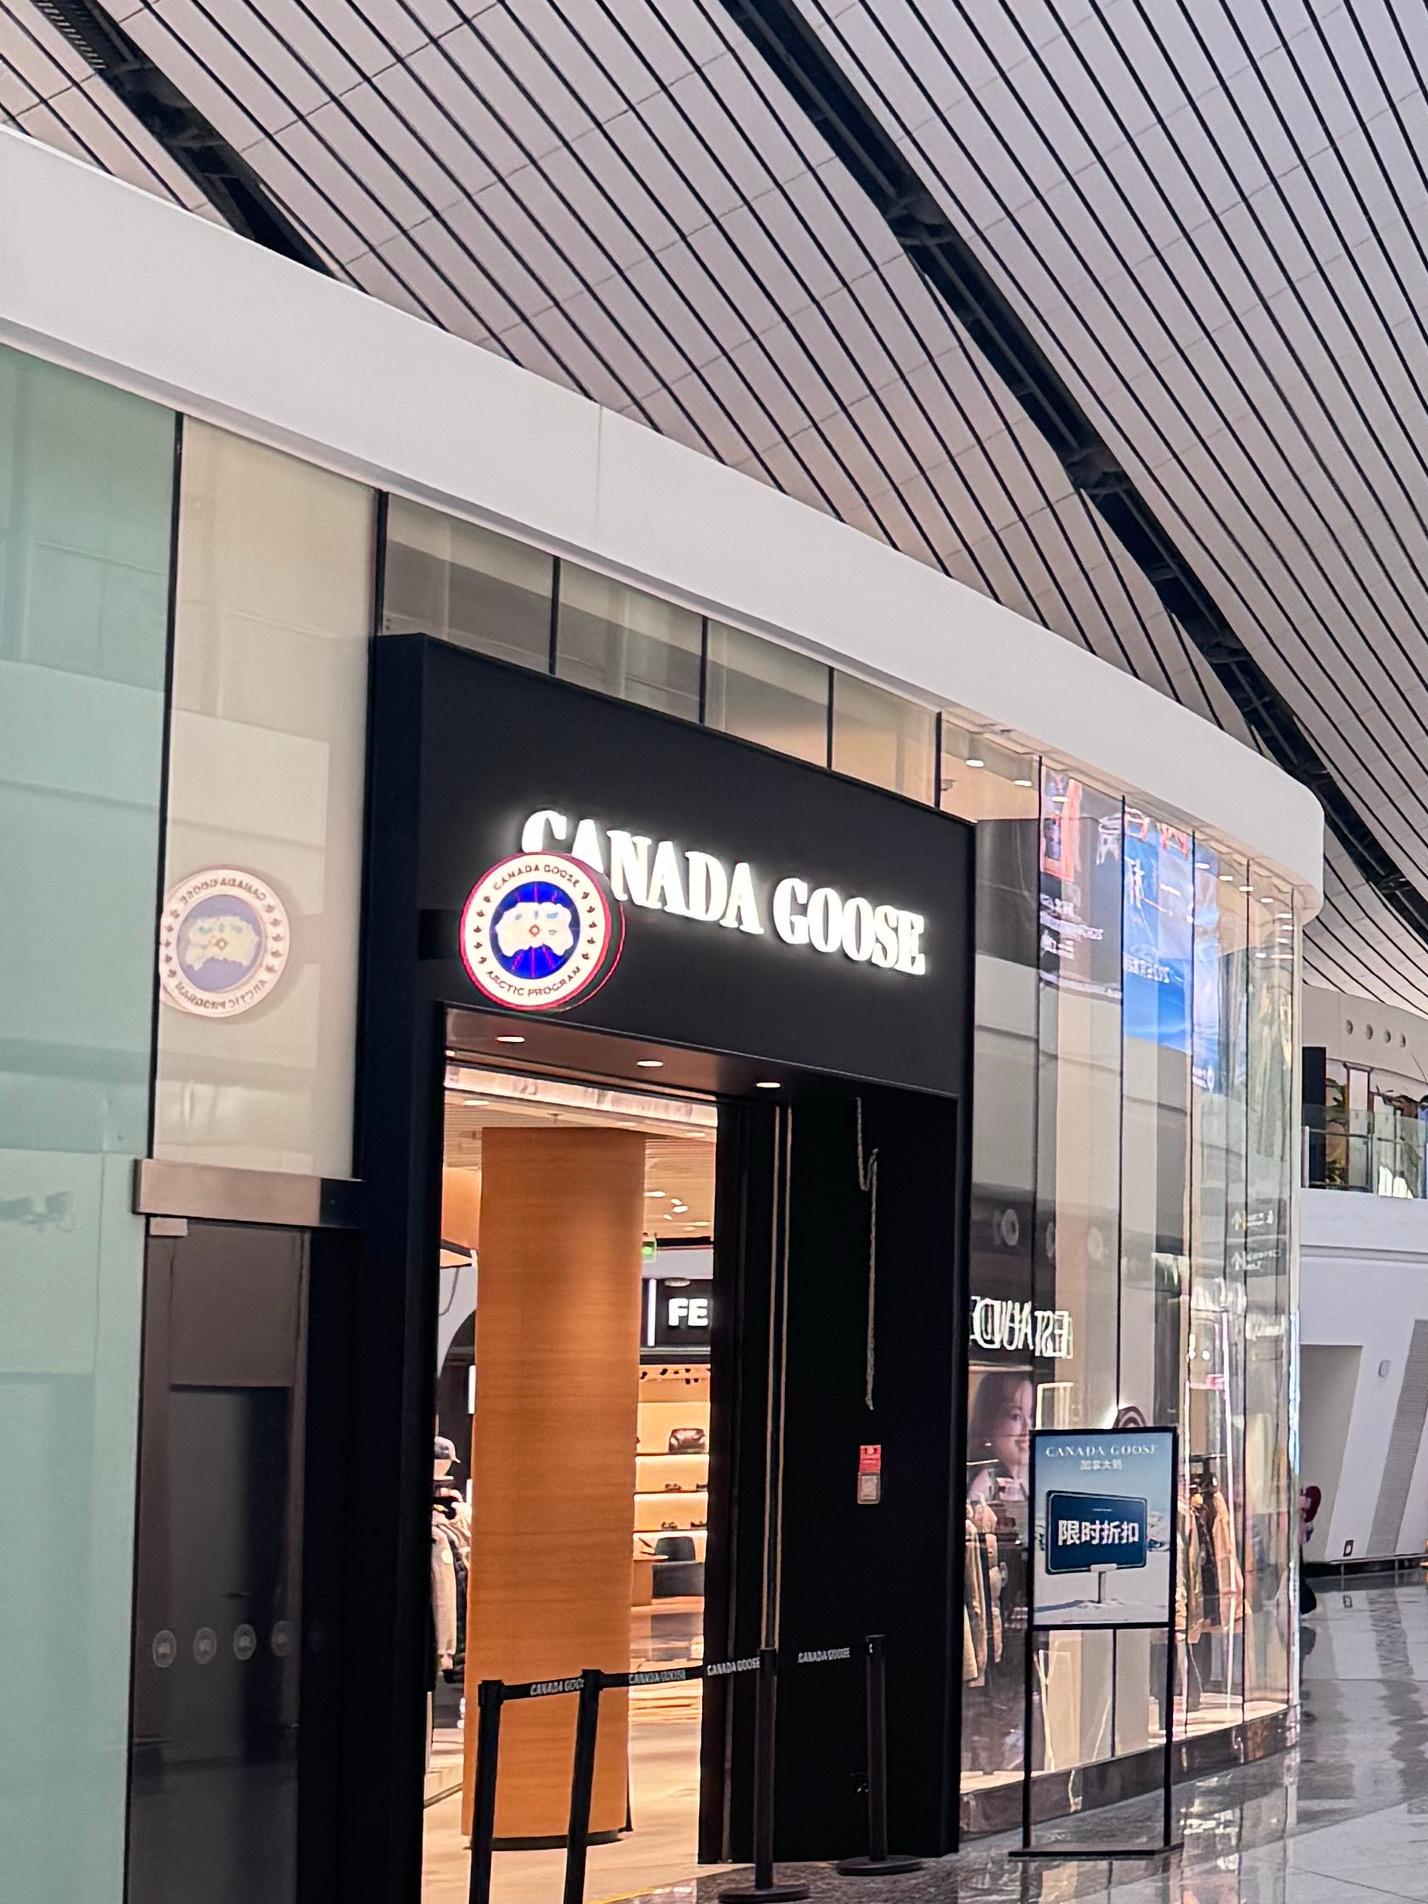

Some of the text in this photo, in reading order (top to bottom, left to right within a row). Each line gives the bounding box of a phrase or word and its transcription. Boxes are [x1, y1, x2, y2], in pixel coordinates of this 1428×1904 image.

[521, 809, 765, 935] CANADA
[773, 877, 926, 976] GOOSE
[668, 1297, 709, 1327] FE
[1045, 1444, 1159, 1457] CANADA GOOSE
[1057, 1519, 1140, 1546] 限时折扣
